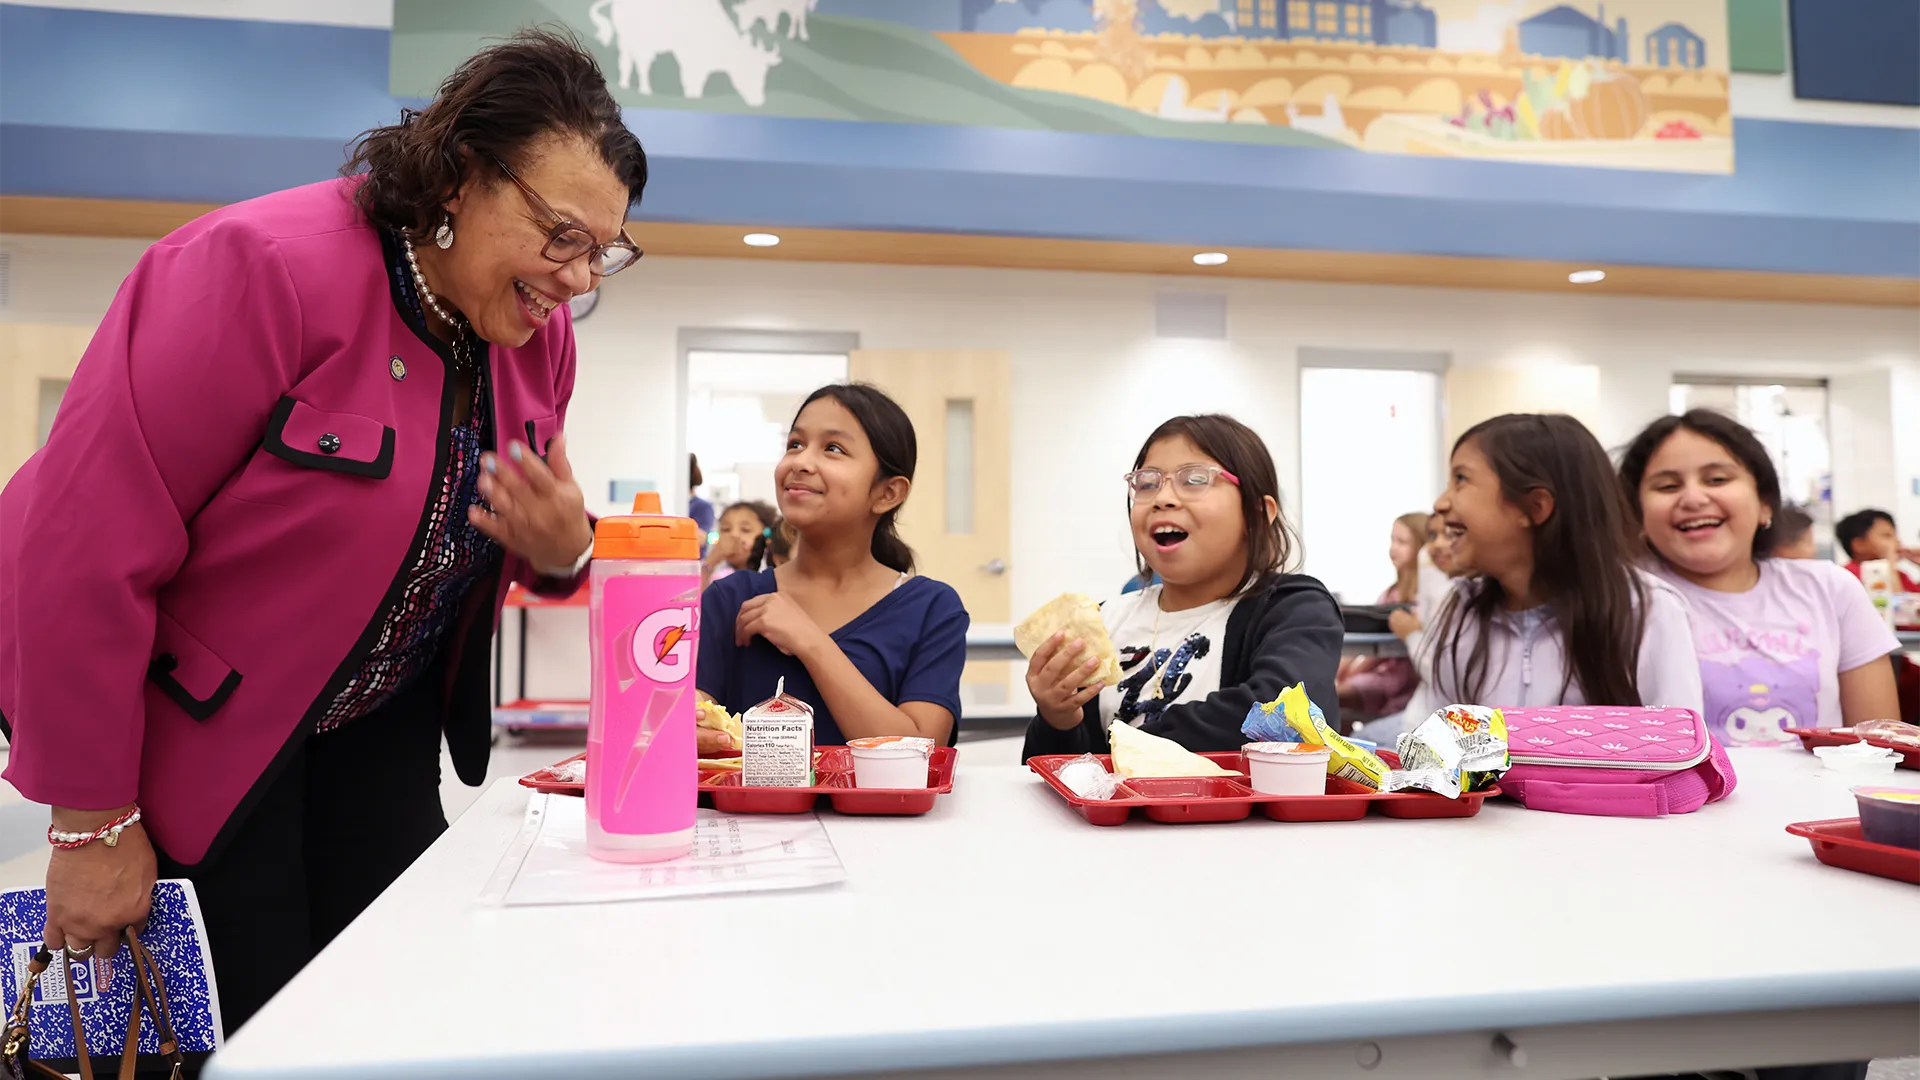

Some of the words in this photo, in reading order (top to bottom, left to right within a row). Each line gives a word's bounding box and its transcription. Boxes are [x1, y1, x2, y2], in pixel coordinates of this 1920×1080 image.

[1330, 732, 1344, 744] CHEWY
[1342, 742, 1356, 752] CANDY
[50, 959, 58, 998] UCATION
[70, 961, 90, 995] ea
[99, 958, 108, 990] mazing
